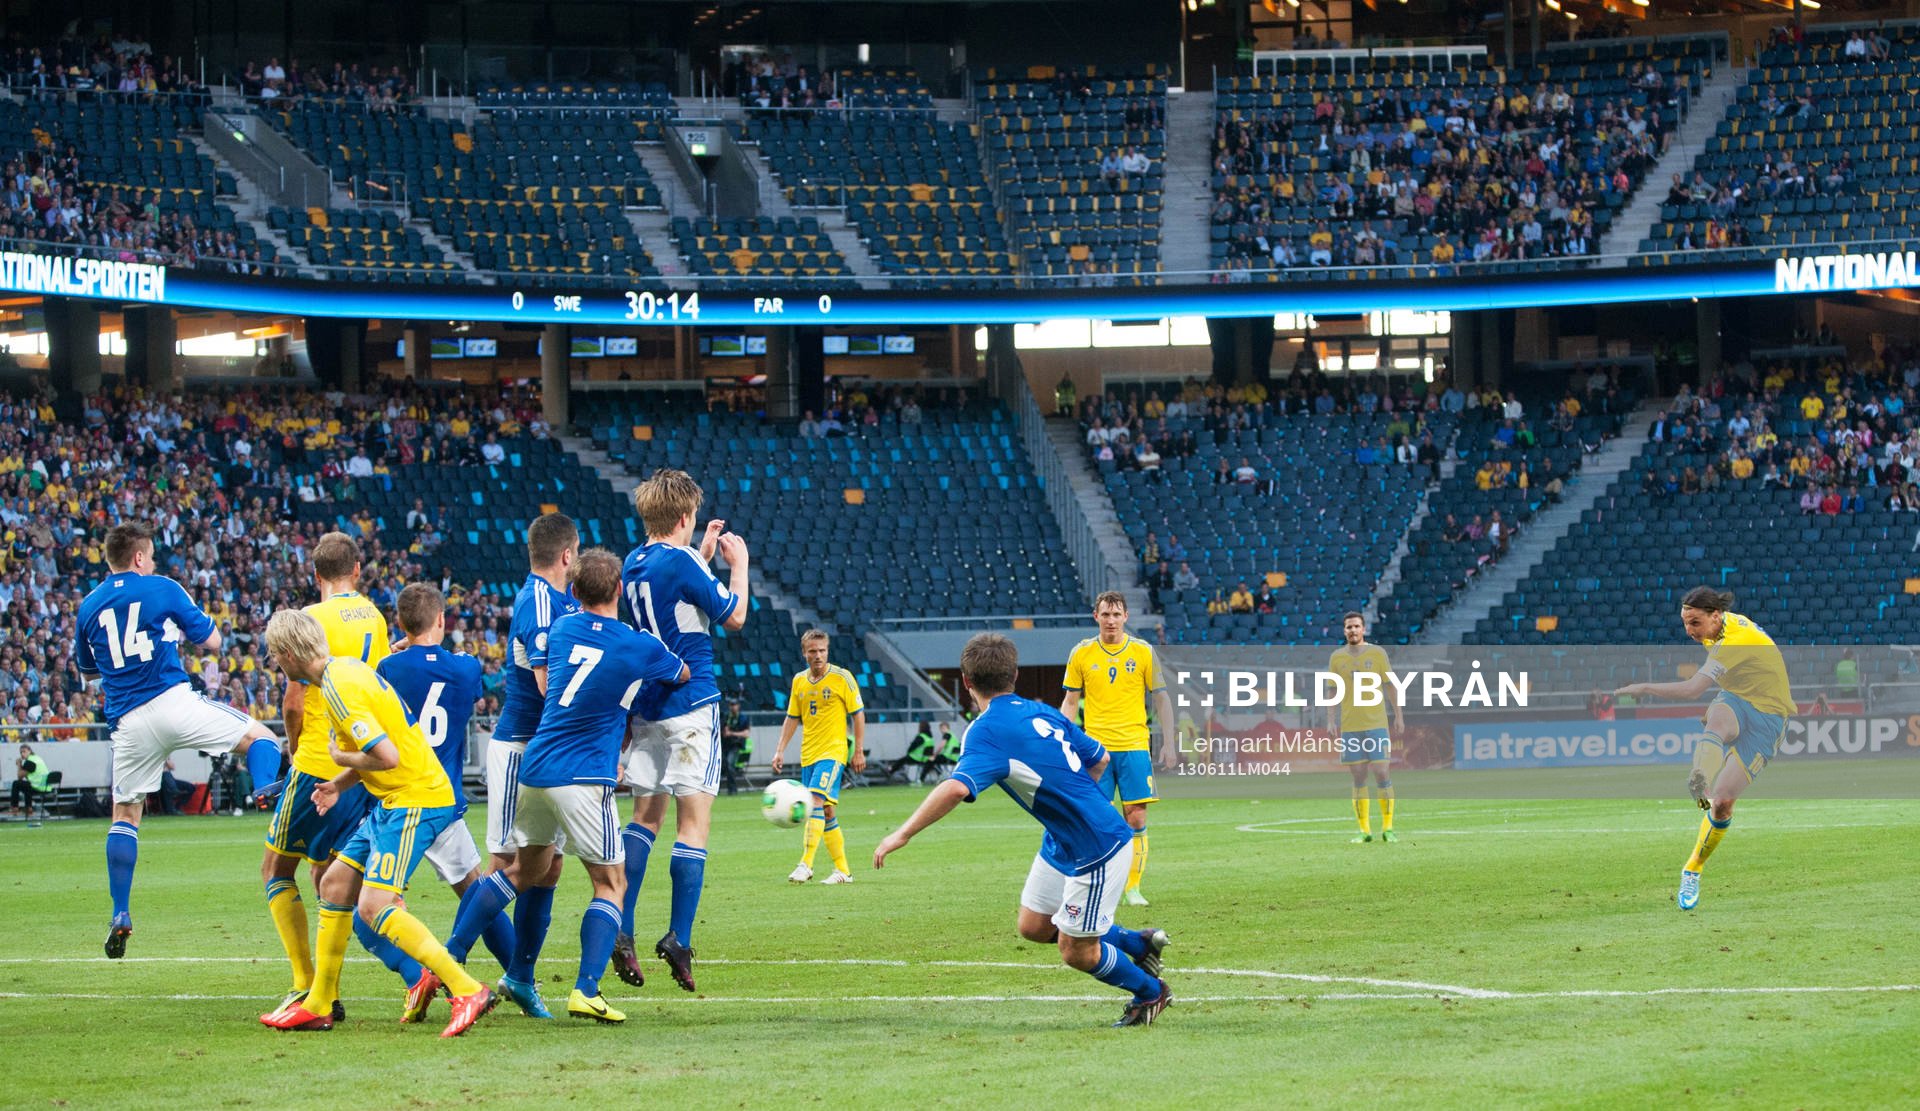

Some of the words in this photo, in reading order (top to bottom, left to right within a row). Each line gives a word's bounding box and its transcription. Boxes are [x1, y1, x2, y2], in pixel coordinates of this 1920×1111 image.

[1775, 251, 1920, 292] NATIONAL
[512, 291, 524, 311] 0
[553, 295, 582, 312] SWE
[625, 291, 700, 321] 30:14
[754, 297, 784, 313] FAR
[818, 295, 832, 314] 0
[626, 581, 662, 642] 11
[98, 601, 155, 669] 14
[558, 644, 605, 708] 7
[1108, 666, 1117, 684] 9
[419, 682, 448, 747] 6
[810, 701, 817, 715] 5
[1032, 718, 1082, 773] 2
[819, 772, 830, 788] 5
[367, 852, 396, 880] 20
